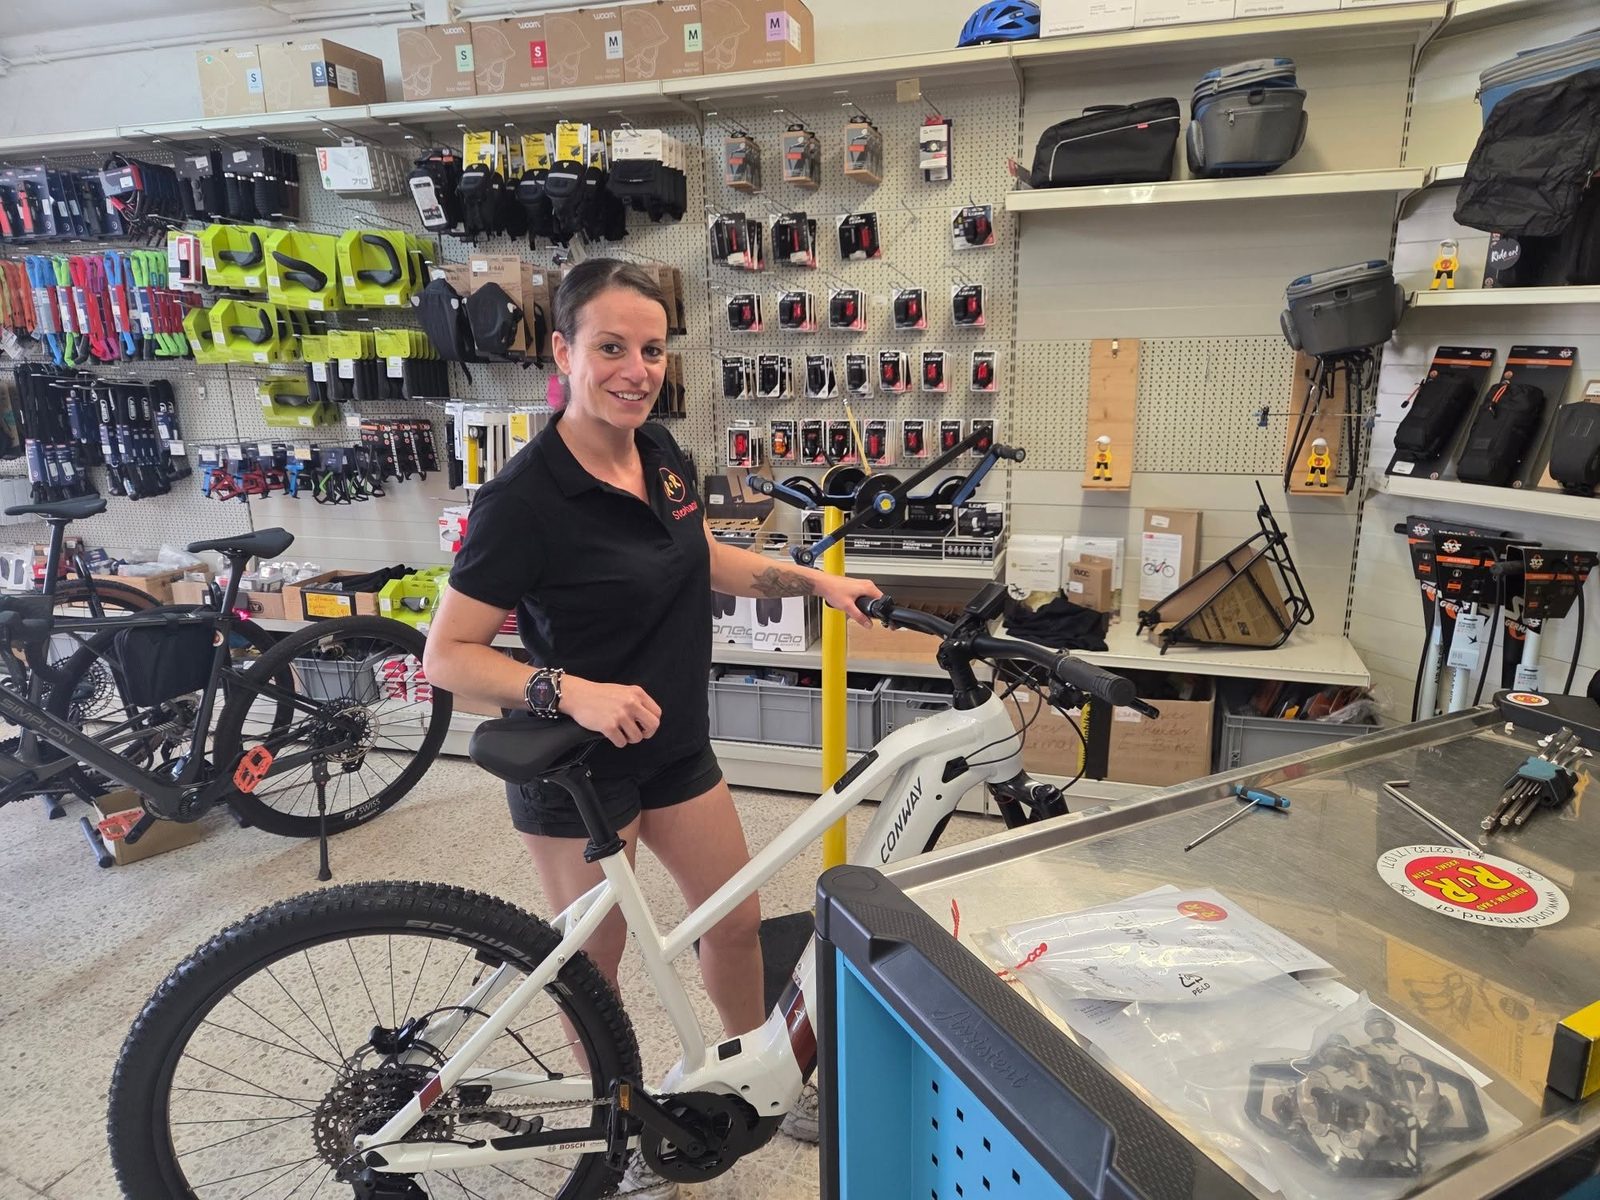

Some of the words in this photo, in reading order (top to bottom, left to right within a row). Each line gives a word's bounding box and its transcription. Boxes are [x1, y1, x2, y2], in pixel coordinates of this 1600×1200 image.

[672, 5, 697, 13] woom
[593, 12, 617, 20] woom
[518, 21, 541, 29] woom
[769, 18, 780, 29] M
[443, 28, 466, 36] woom
[688, 29, 699, 40] M
[609, 37, 619, 47] M
[460, 50, 467, 60] S
[534, 46, 541, 57] S
[315, 66, 322, 77] S
[328, 66, 335, 78] S
[251, 73, 257, 82] S
[1491, 249, 1507, 263] Ride
[1413, 525, 1430, 534] SKS
[1441, 542, 1462, 551] SKS
[1529, 559, 1544, 567] SKS
[1074, 569, 1090, 578] evoc
[0, 698, 74, 745] SIMPLON
[344, 810, 356, 820] DT
[359, 798, 380, 814] SWISS
[880, 776, 922, 863] CONWAY
[1413, 846, 1454, 855] 02732
[1436, 859, 1460, 871] KREMS
[1411, 868, 1433, 880] STEIN
[1457, 865, 1513, 890] R
[1423, 878, 1480, 903] R
[1507, 887, 1529, 898] RUND
[1435, 891, 1559, 926] www.rundumsrad.at
[1476, 899, 1492, 911] RAD
[1191, 982, 1211, 997] PE-LD
[559, 1143, 586, 1151] BOSCH
